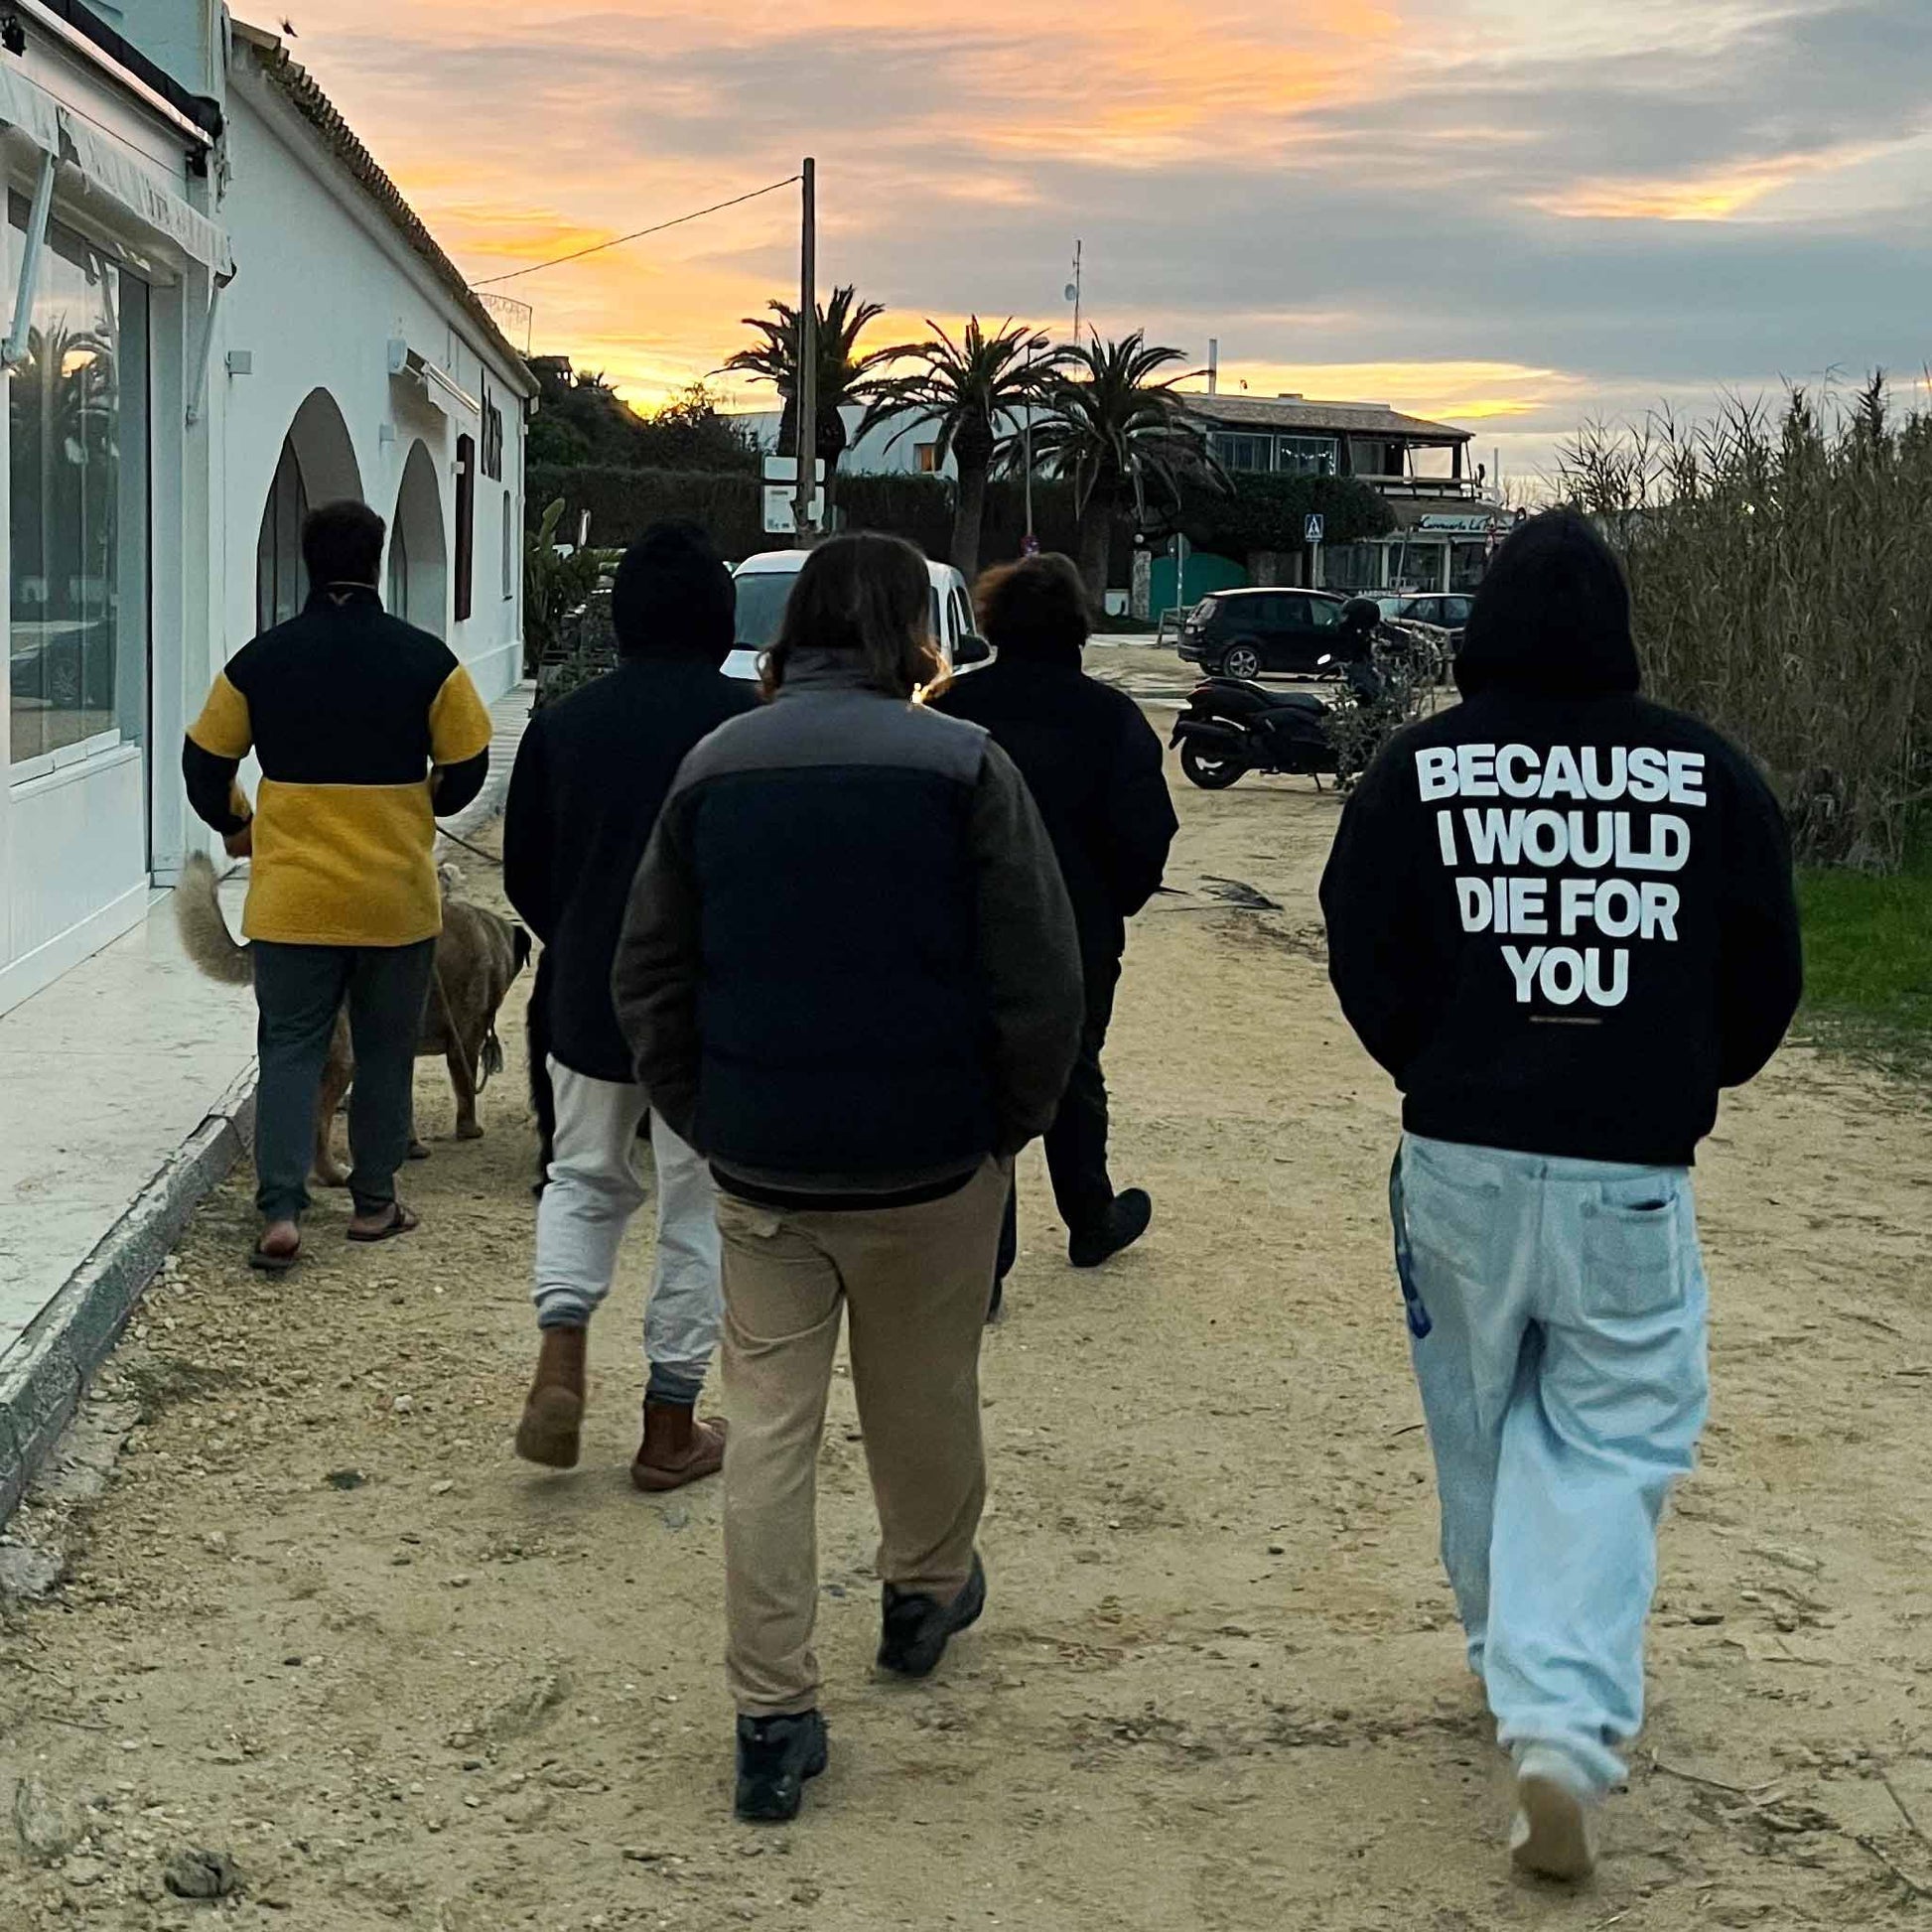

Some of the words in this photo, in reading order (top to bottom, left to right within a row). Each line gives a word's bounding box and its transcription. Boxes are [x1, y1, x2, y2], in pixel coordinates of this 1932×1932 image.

[1415, 744, 1707, 807] BECAUSE
[1437, 809, 1457, 867] I
[1463, 808, 1691, 872] WOULD
[1455, 877, 1548, 935] DIE
[1561, 879, 1680, 941] FOR
[1501, 945, 1629, 1007] YOU
